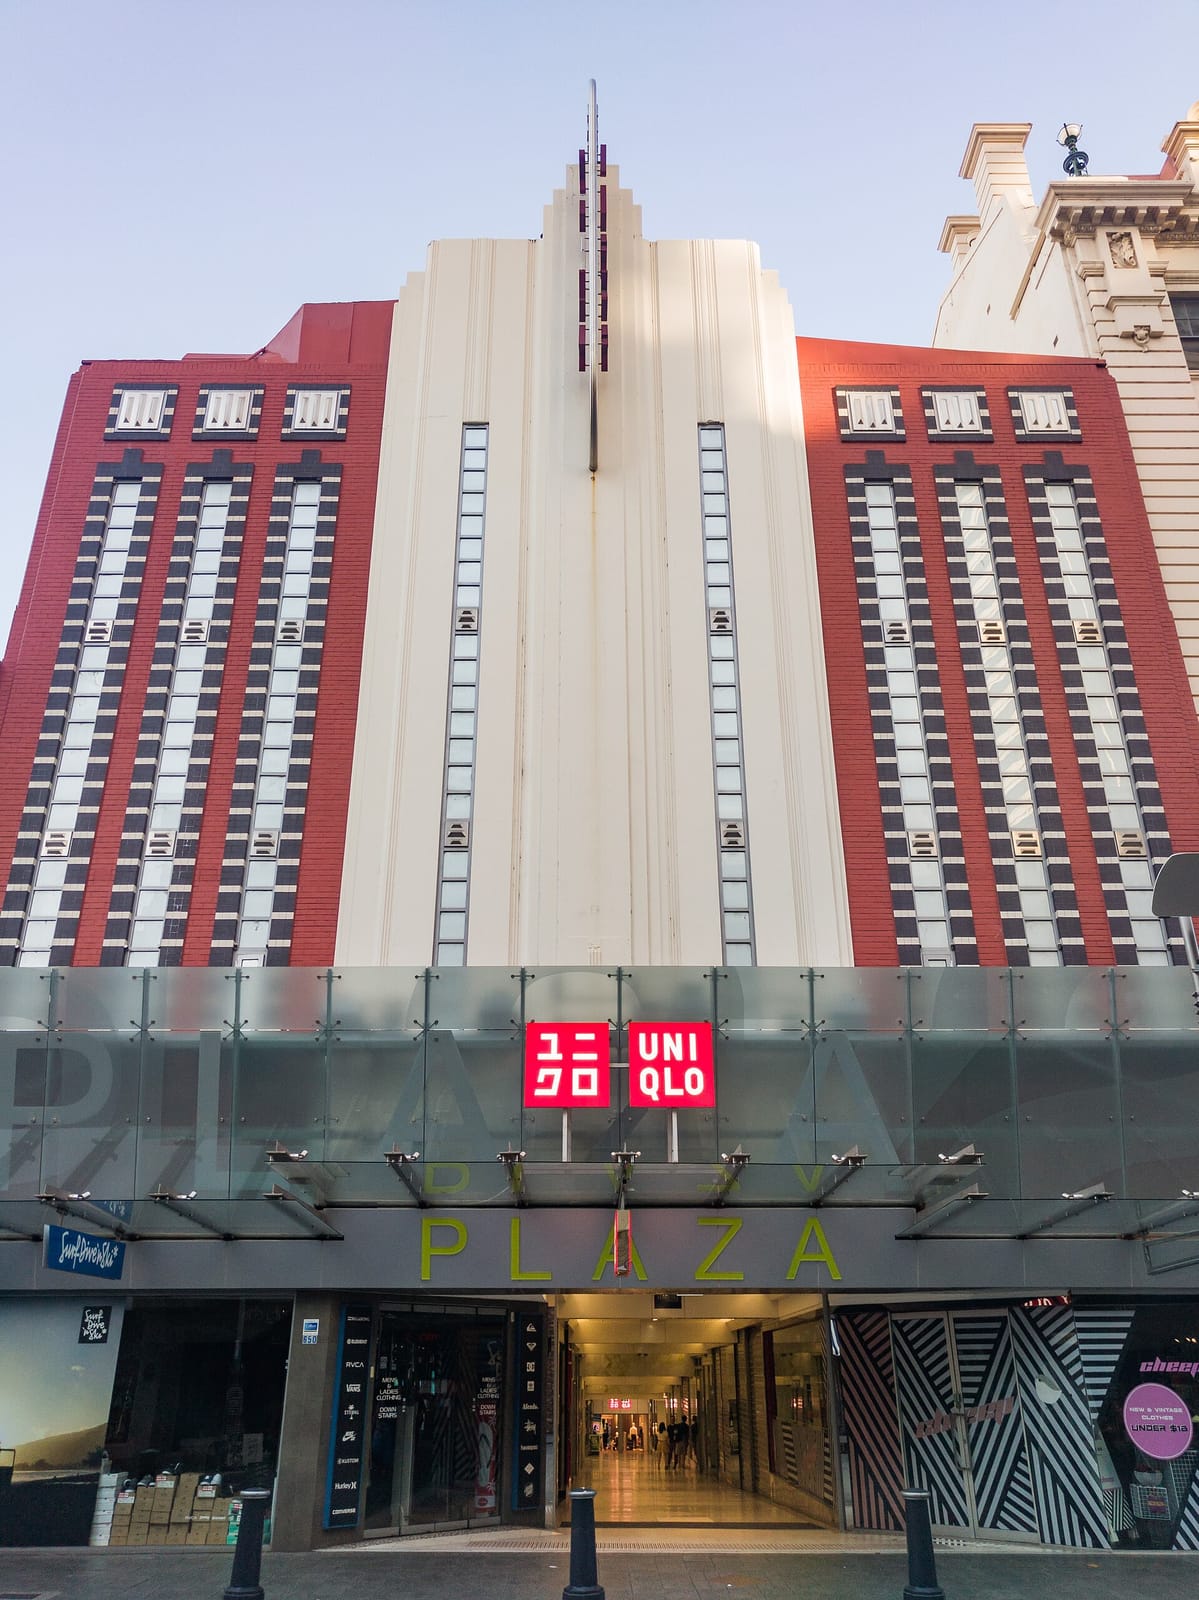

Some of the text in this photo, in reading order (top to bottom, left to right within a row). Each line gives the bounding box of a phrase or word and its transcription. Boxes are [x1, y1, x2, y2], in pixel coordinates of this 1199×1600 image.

[536, 1032, 598, 1061] ユニ
[638, 1032, 697, 1062] UNI
[534, 1067, 598, 1096] クロ
[639, 1066, 705, 1101] QLO
[420, 1216, 842, 1281] PLAZA
[345, 1361, 365, 1369] RVCA
[1131, 1424, 1166, 1432] UNDER
